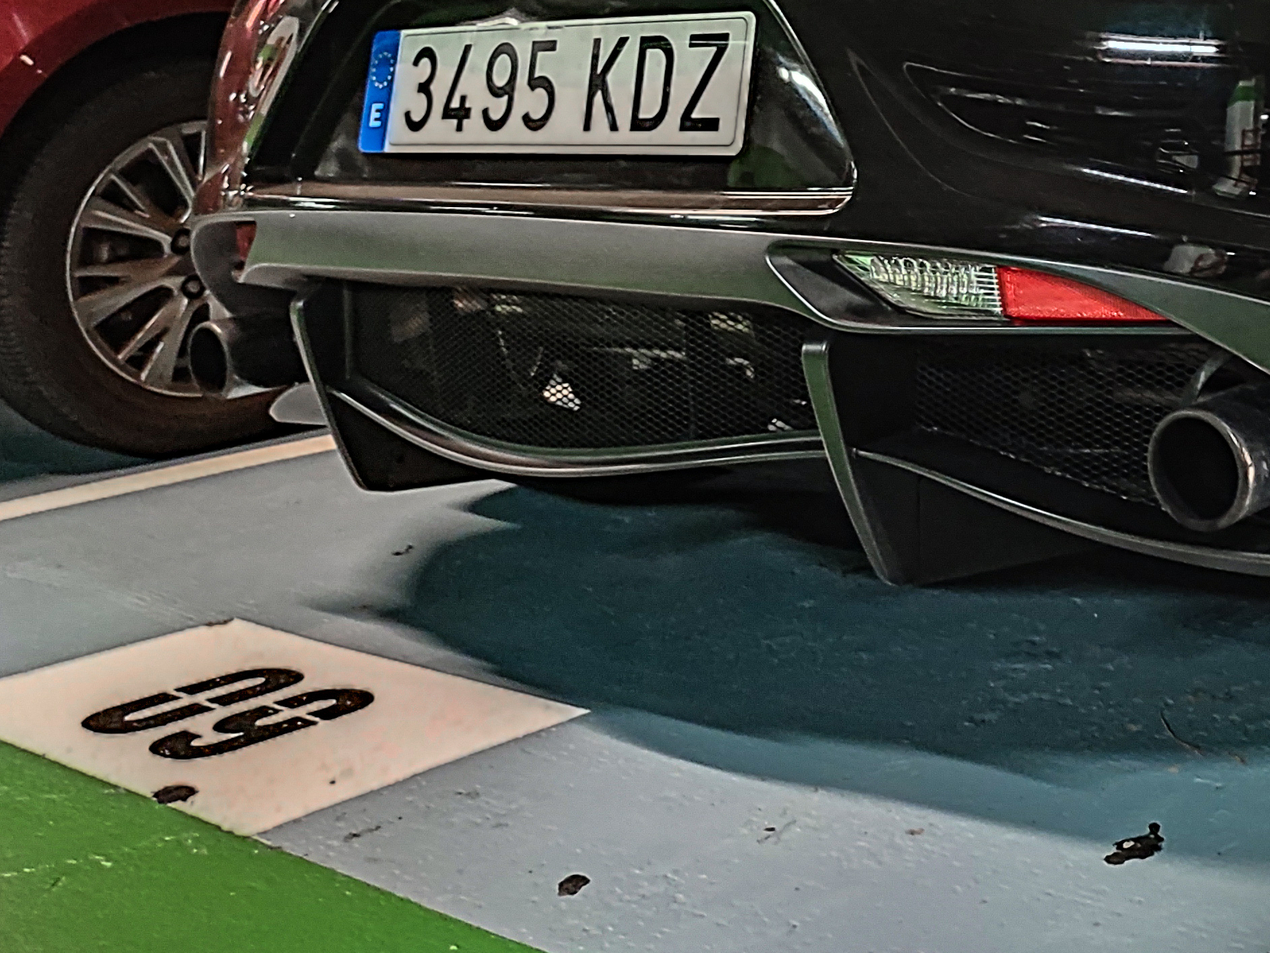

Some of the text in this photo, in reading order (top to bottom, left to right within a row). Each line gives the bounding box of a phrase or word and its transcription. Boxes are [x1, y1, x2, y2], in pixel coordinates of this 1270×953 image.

[404, 33, 731, 132] 3495 KDZ
[368, 103, 384, 128] E
